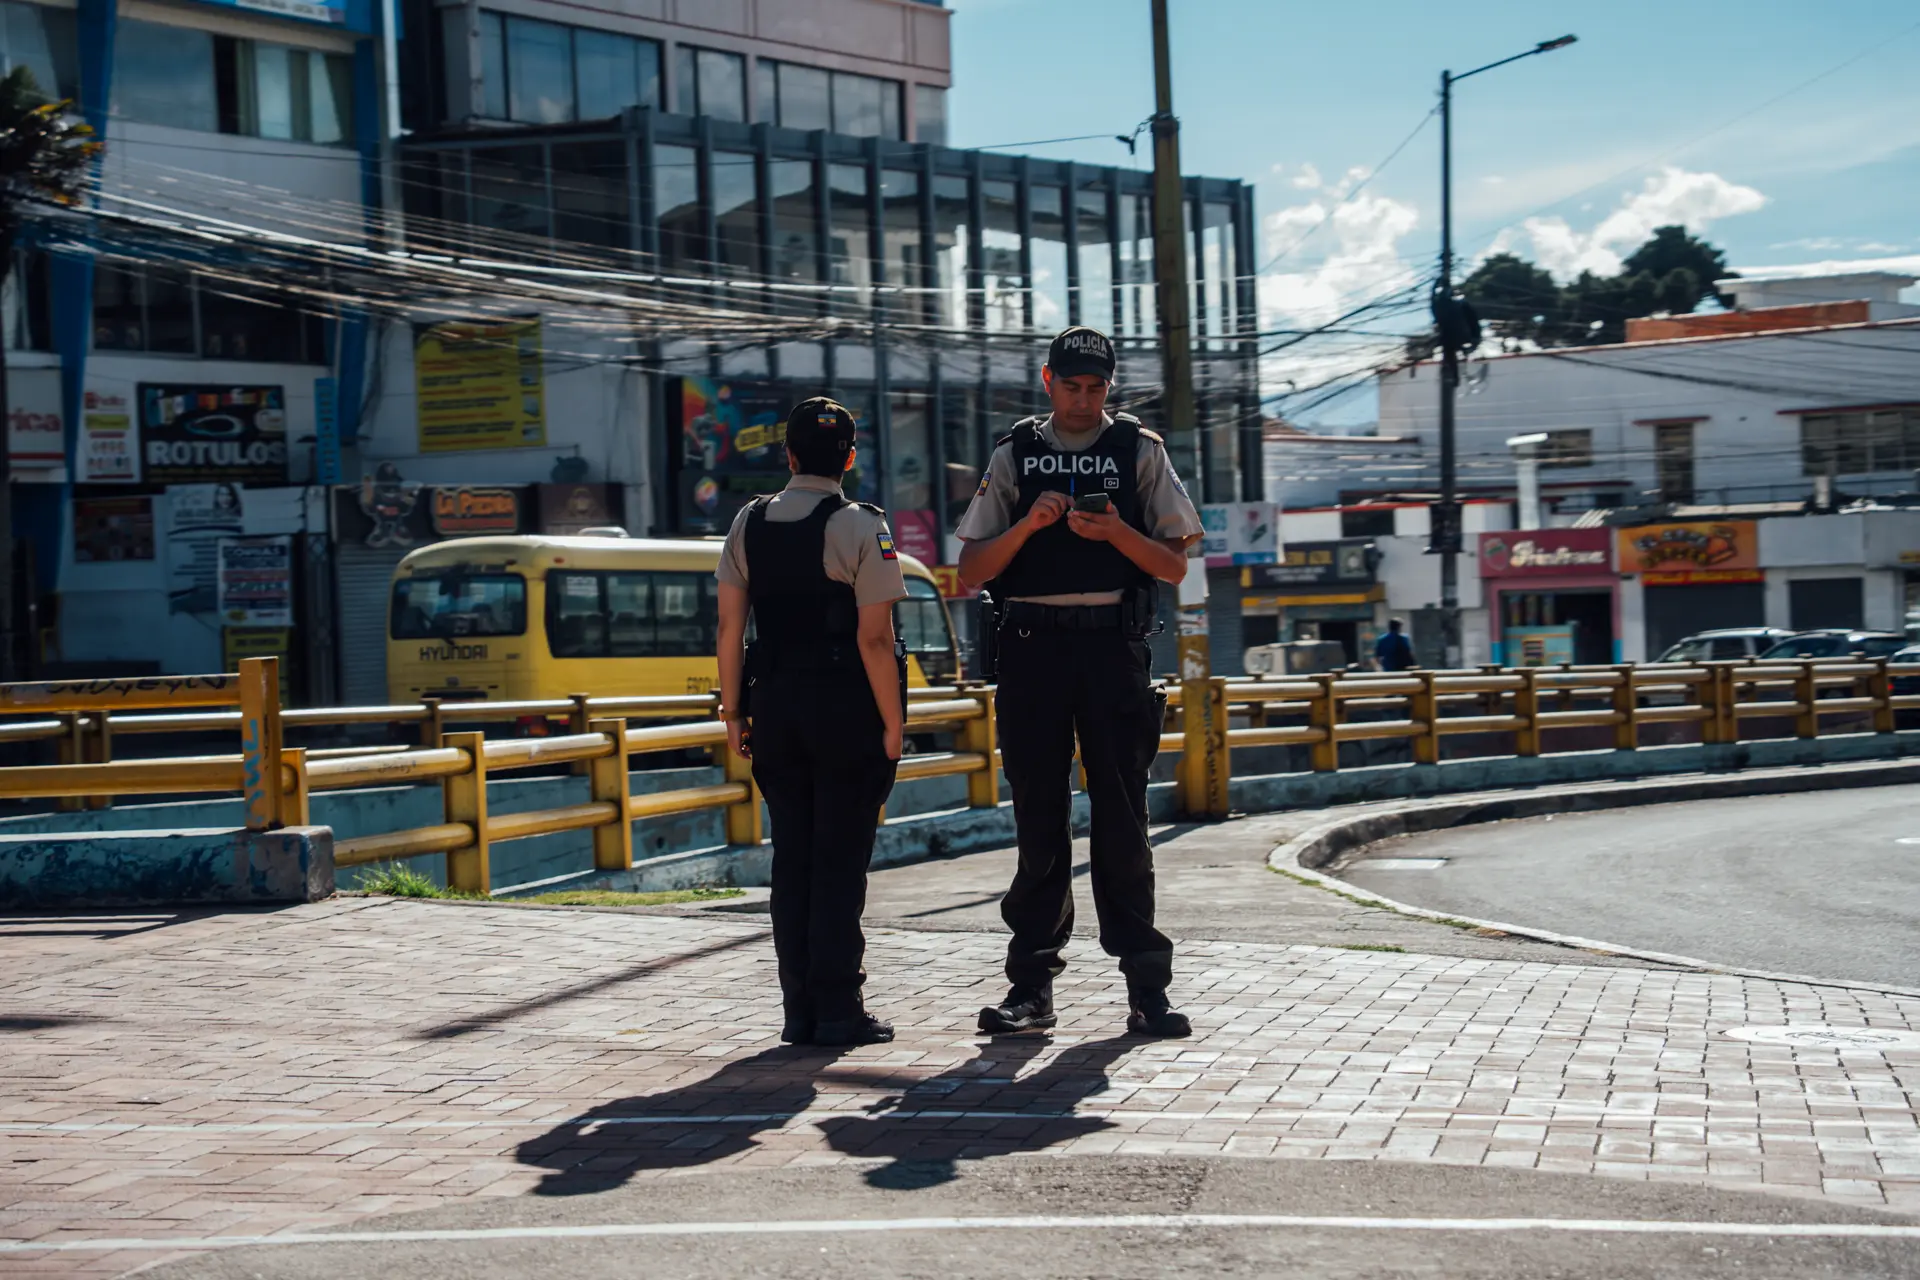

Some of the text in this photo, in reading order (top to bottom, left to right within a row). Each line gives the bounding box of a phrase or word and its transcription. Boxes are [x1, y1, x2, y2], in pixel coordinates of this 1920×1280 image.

[1063, 334, 1108, 352] POLICIA
[1079, 347, 1109, 360] NACIONAL
[145, 440, 286, 466] ROTULOS
[1023, 455, 1118, 476] POLICIA
[419, 643, 488, 661] HYUNDAI
